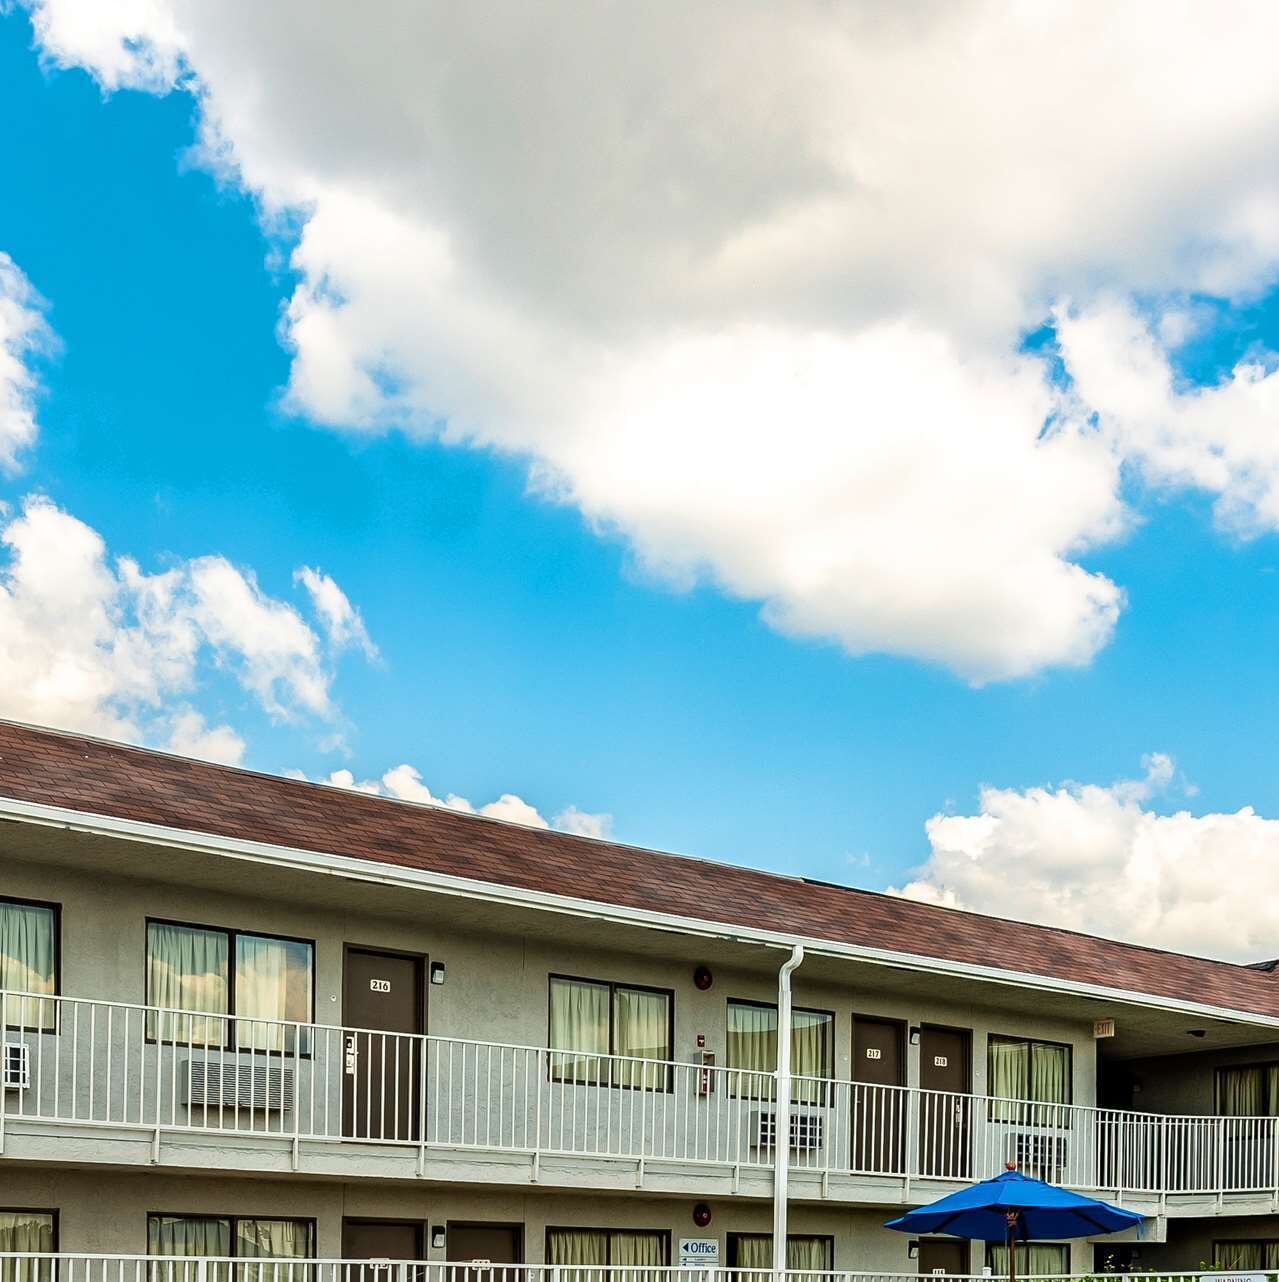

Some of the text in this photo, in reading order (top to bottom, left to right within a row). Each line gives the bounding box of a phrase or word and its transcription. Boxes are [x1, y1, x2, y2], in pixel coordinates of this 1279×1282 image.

[372, 981, 388, 991] 216
[868, 1050, 879, 1058] 217
[691, 1242, 716, 1253] Office
